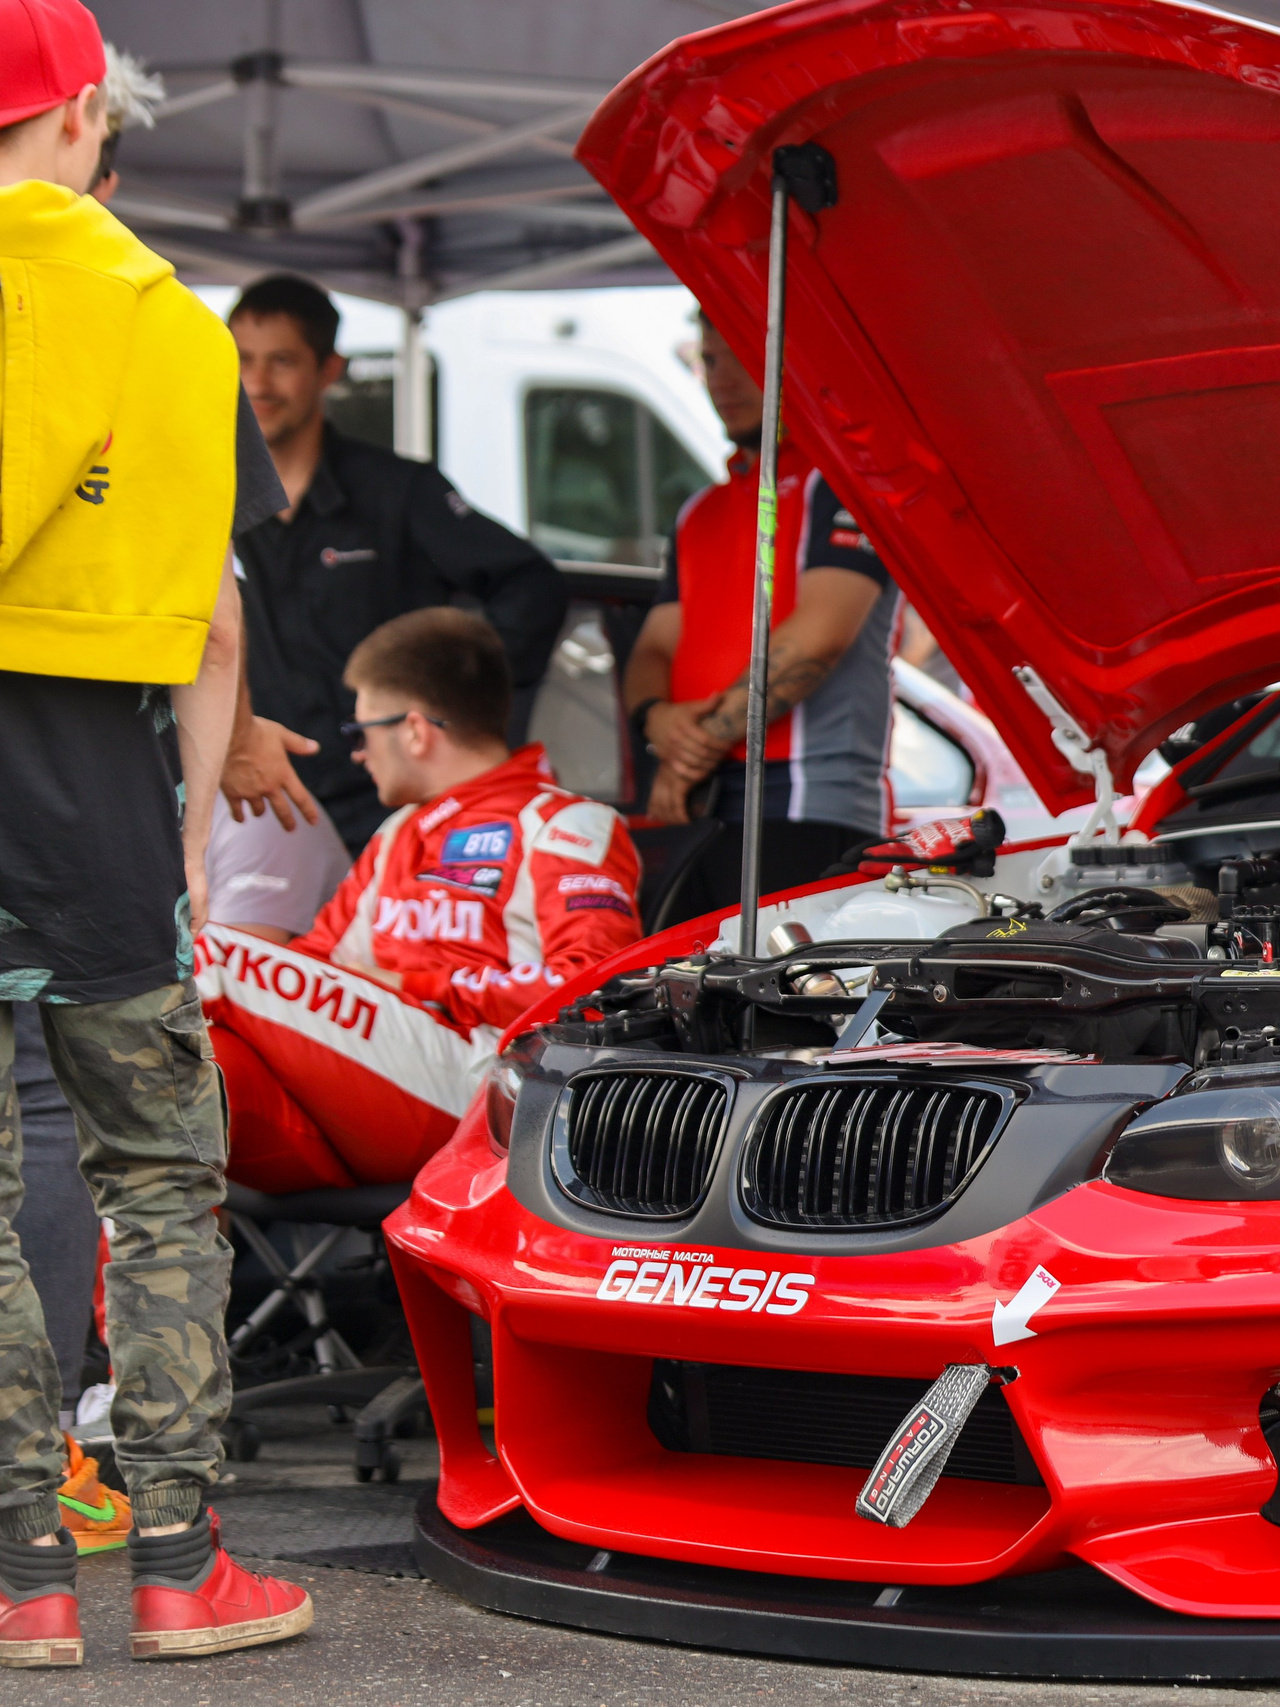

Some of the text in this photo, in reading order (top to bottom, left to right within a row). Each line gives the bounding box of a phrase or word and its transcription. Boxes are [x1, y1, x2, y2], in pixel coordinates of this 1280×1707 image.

[462, 828, 508, 858] ВТБ
[611, 1246, 715, 1264] МОТОРНЫЕ МАСЛА
[597, 1259, 816, 1315] GENESIS
[870, 1416, 926, 1498] RACING
[875, 1419, 939, 1511] FORWARD
